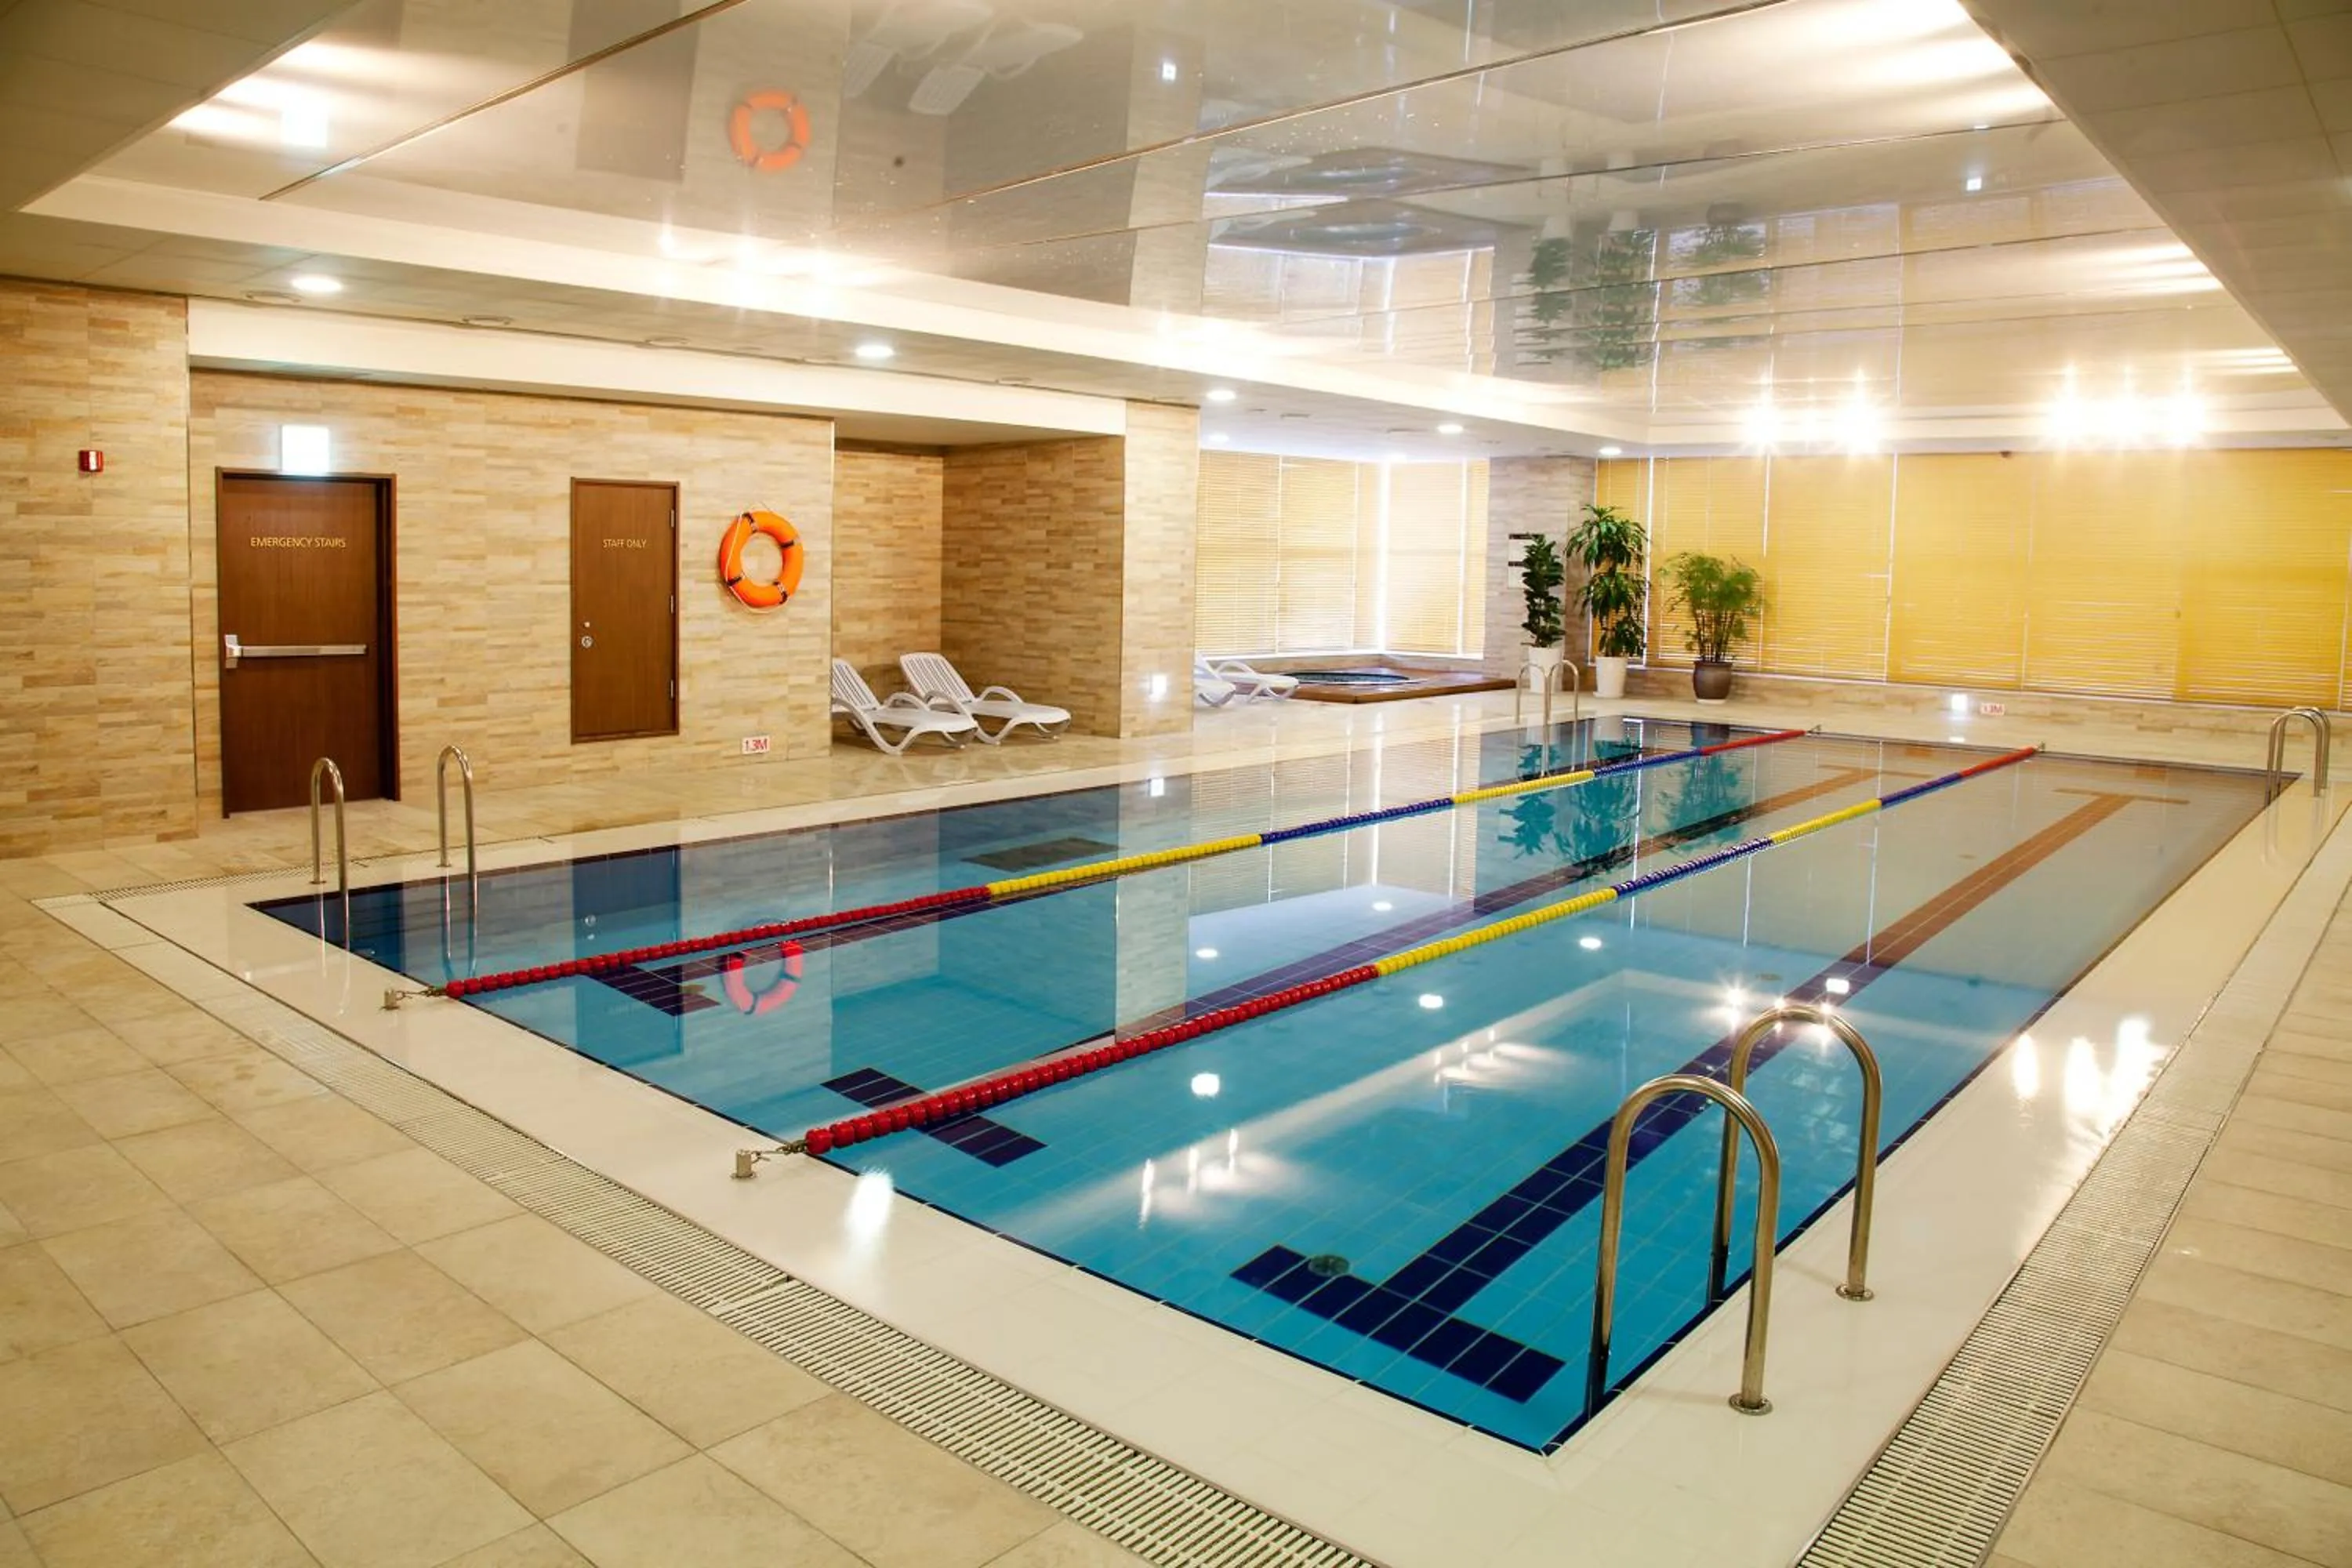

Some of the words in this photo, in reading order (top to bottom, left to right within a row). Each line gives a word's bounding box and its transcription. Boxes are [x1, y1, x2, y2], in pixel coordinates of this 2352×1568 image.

[250, 537, 312, 547] EMERGENCY
[314, 537, 347, 548] STAIRS
[602, 539, 625, 549] STAFF
[626, 539, 647, 549] ONLY
